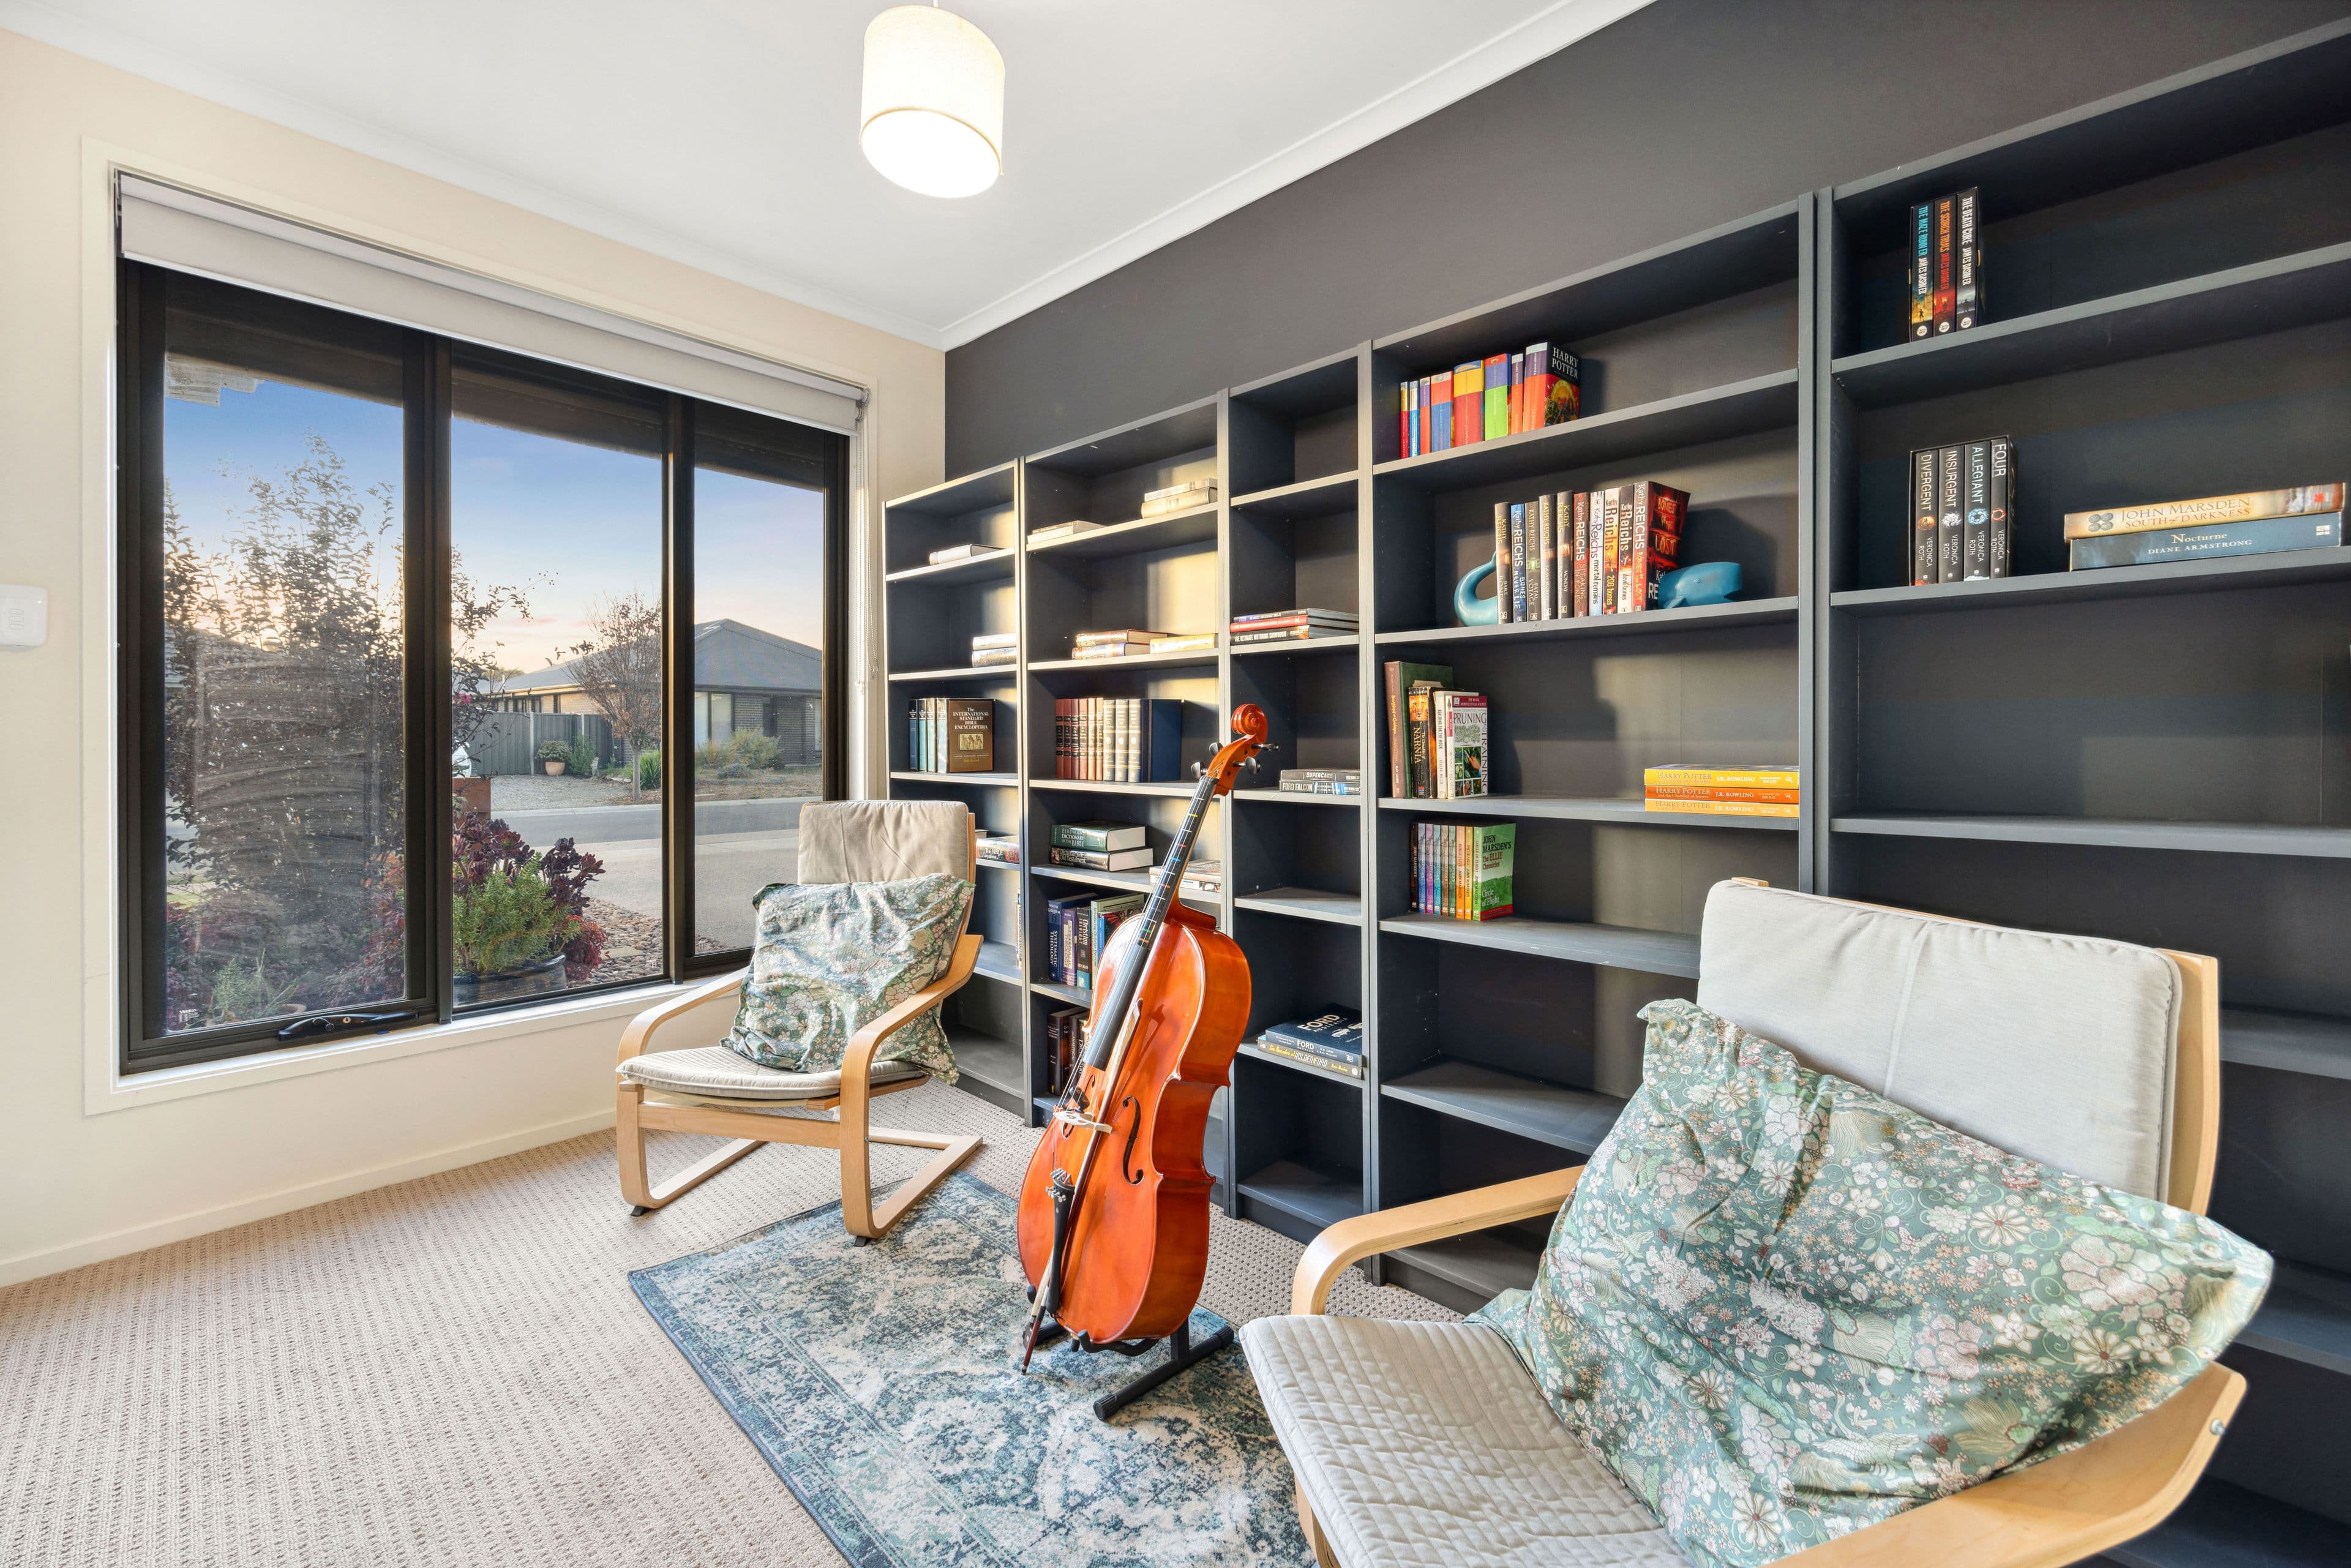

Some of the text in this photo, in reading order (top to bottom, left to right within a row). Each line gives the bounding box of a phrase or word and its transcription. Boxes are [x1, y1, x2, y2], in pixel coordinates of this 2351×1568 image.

[1918, 205, 1928, 256] THE MAZE RUNNER
[1940, 201, 1950, 253] THE SCORCH TRIALS
[1962, 197, 1973, 245] THE DEATH CURE
[1918, 257, 1928, 295] JAMES DASHNER
[1940, 253, 1949, 290] JAMES DASHNER
[1962, 247, 1972, 286] JAMES DASHNER
[1553, 347, 1579, 368] HARRY
[1551, 358, 1578, 380] POTTER
[1994, 443, 2006, 477] FOUR
[1920, 454, 1932, 511] DIVERGENT
[1945, 451, 1957, 507] INSURGENT
[1971, 446, 1984, 503] ALLEGIANT
[1635, 484, 1645, 550] Kathy REICHS
[1658, 498, 1676, 514] BONES
[2120, 497, 2251, 523] JOHN MARSDEN
[1605, 507, 1618, 551] Reichs
[2125, 508, 2251, 528] SOUTH DARKNESS
[1575, 501, 1585, 561] Kathy REICHS
[1591, 508, 1602, 558] Kathy Reichs
[1621, 511, 1632, 551] Reichs
[2170, 532, 2227, 544] Nocturne
[1513, 529, 1523, 567] REICHS
[1655, 535, 1677, 557] LOST
[2148, 539, 2253, 554] DIANE ARMSTRONG
[1453, 713, 1487, 724] PRUNING
[1295, 783, 1313, 792] FALCON
[1482, 841, 1512, 853] MARSDEN'S
[1483, 835, 1496, 844] JOHN
[1482, 861, 1499, 870] Chronicles
[1490, 852, 1503, 860] ELLIE
[1482, 888, 1494, 898] Circle
[1487, 896, 1499, 906] Flight
[1297, 1015, 1340, 1031] FORD
[1313, 1018, 1349, 1032] AUSTRALIA
[1297, 1040, 1314, 1050] FORD
[1294, 1052, 1313, 1063] HOLDEN
[1314, 1057, 1328, 1067] FORD
